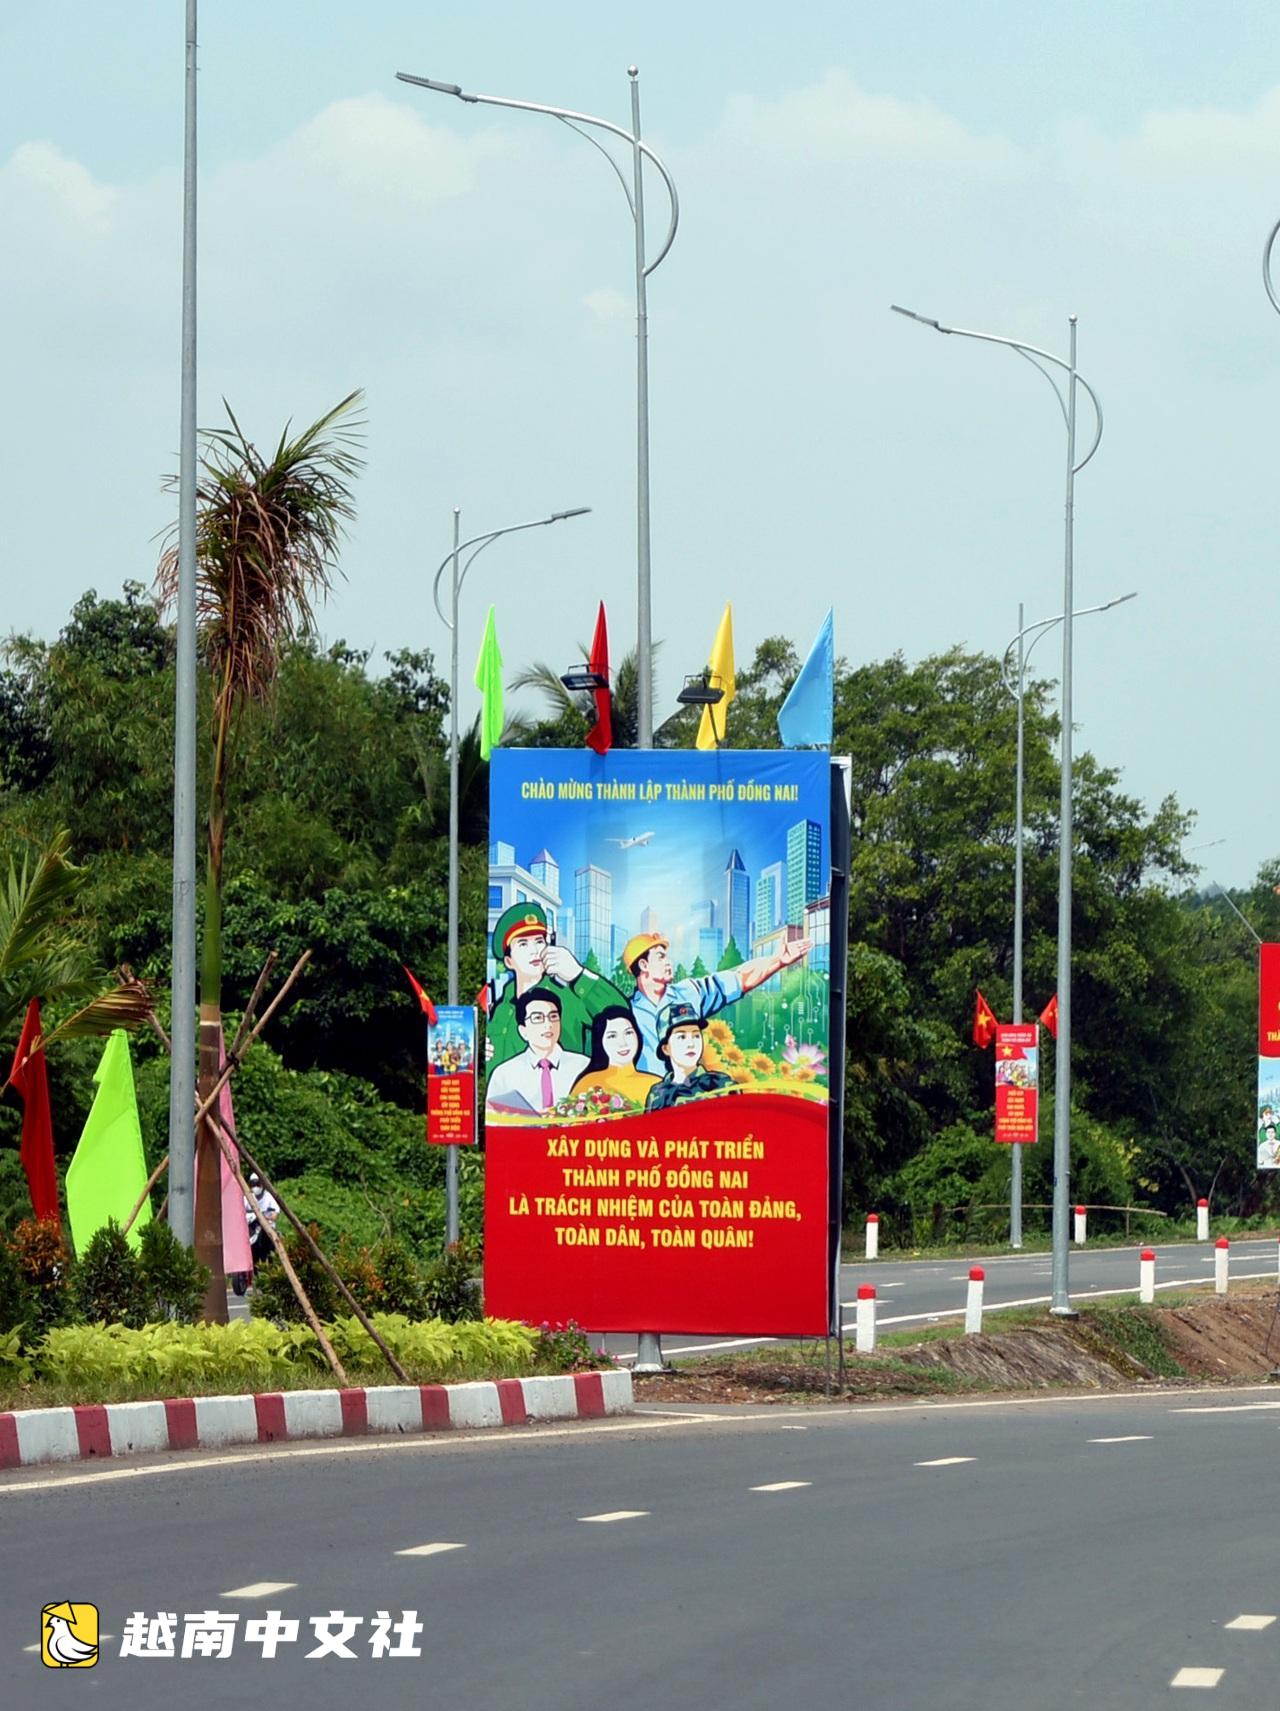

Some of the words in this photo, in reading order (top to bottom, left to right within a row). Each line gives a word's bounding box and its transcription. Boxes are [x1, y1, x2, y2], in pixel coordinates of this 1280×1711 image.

[521, 777, 555, 799] CHÀO
[558, 777, 593, 800] MỪNG
[597, 778, 636, 800] THÀNH
[640, 778, 662, 804] LẬP
[666, 779, 706, 801] THÀNH
[709, 778, 735, 801] PHỐ
[738, 779, 771, 801] ĐỒNG
[774, 784, 798, 801] NAI!
[547, 1134, 580, 1157] XÂY
[584, 1137, 632, 1161] DỰNG
[636, 1136, 660, 1158] VÀ
[664, 1136, 710, 1159] PHÁT
[713, 1134, 764, 1160] TRIỂN
[562, 1164, 620, 1187] THÀNH
[625, 1163, 662, 1188] PHỐ
[665, 1164, 714, 1189] ĐỒNG
[719, 1170, 749, 1189] NAI
[509, 1193, 530, 1216] LÀ
[534, 1193, 592, 1217] TRÁCH
[597, 1194, 654, 1221] NHIỆM
[658, 1194, 695, 1218] CỦA
[698, 1196, 744, 1219] TOÀN
[748, 1195, 802, 1221] ĐẢNG,
[554, 1223, 600, 1246] TOÀN
[605, 1224, 646, 1250] DÂN,
[650, 1225, 696, 1248] TOÀN
[701, 1225, 754, 1249] QUÂN!
